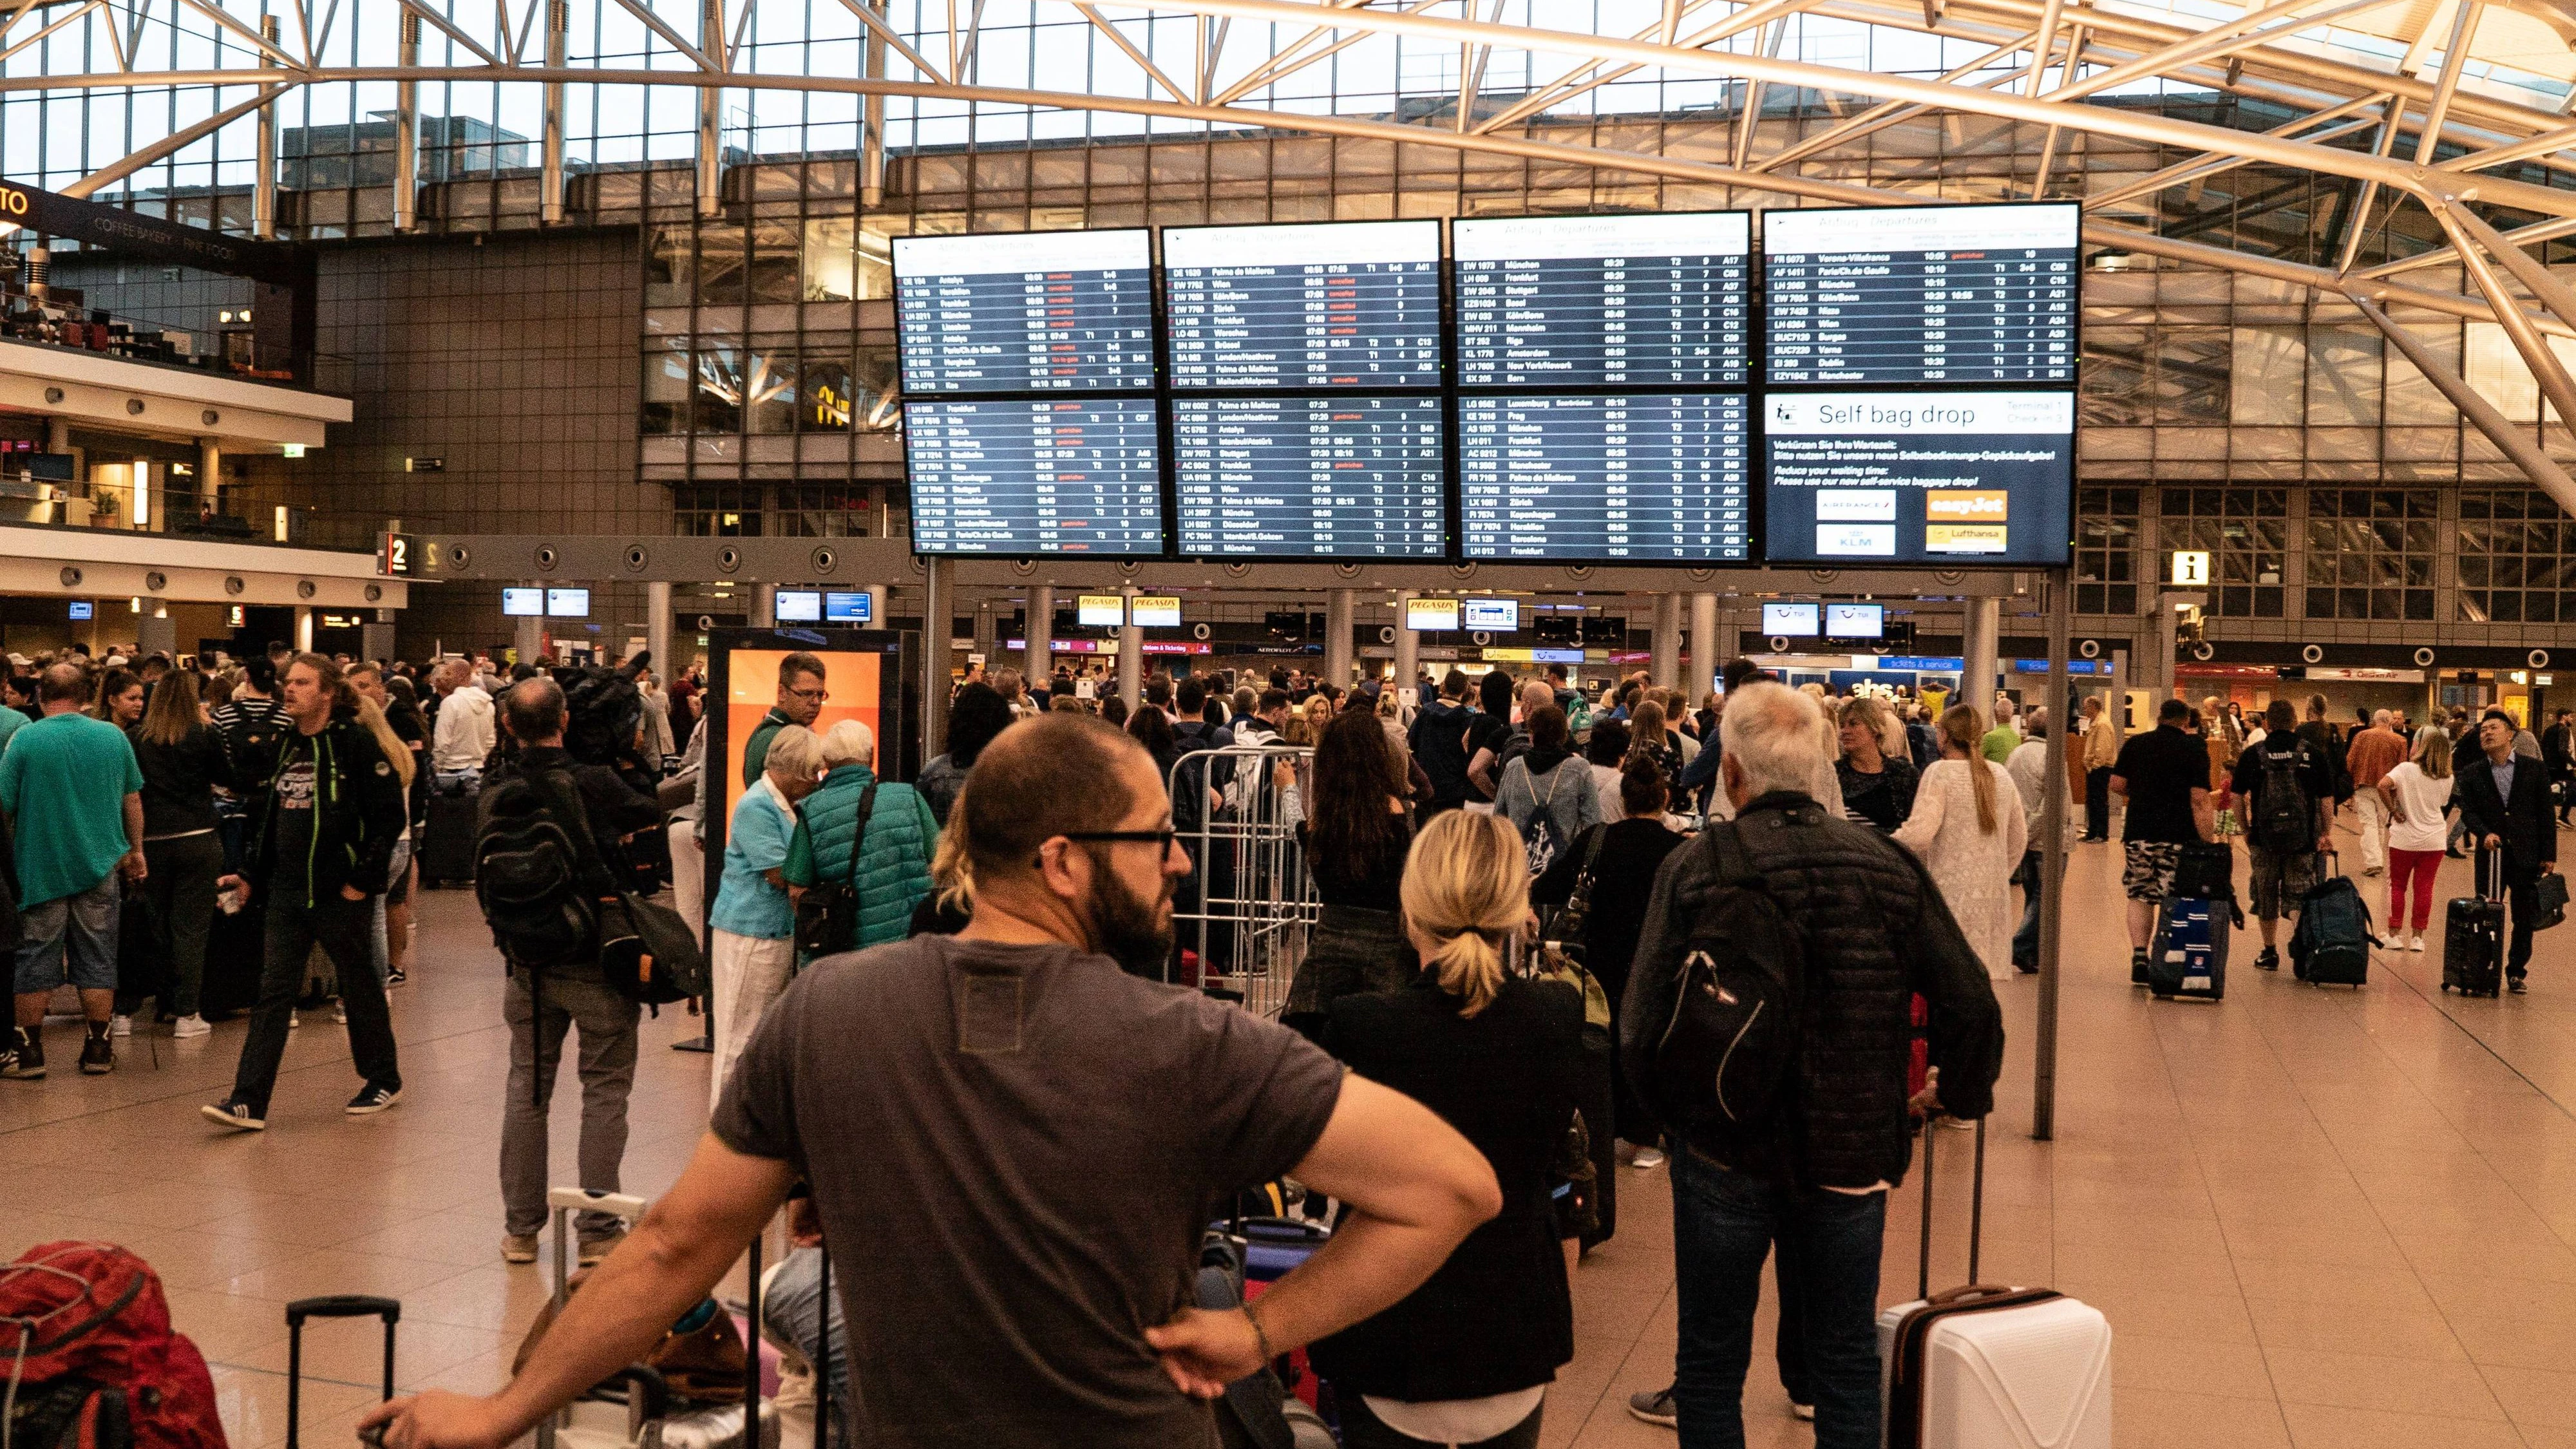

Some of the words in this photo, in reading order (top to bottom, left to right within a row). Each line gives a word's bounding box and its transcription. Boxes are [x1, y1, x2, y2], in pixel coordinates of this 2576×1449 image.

[1870, 215, 1937, 227] Departures
[1554, 223, 1616, 234] Departures
[2007, 402, 2052, 411] Terminal
[2057, 402, 2061, 410] 1
[1819, 404, 1864, 424] Self
[1871, 404, 1912, 428] bag
[1922, 404, 1975, 428] drop
[2007, 414, 2051, 423] Check-in
[2056, 414, 2062, 422] 3
[1819, 440, 1833, 450] Sie
[1835, 440, 1853, 449] Ihre
[1774, 451, 1794, 460] Bitte
[1827, 451, 1842, 460] Sie
[1774, 466, 1807, 475] Reduce
[1831, 466, 1864, 477] waiting
[1774, 477, 1803, 485] Please
[1912, 477, 1951, 488] baggage
[1931, 498, 2003, 514] easyJet
[392, 540, 406, 563] 2
[2186, 555, 2197, 580] i
